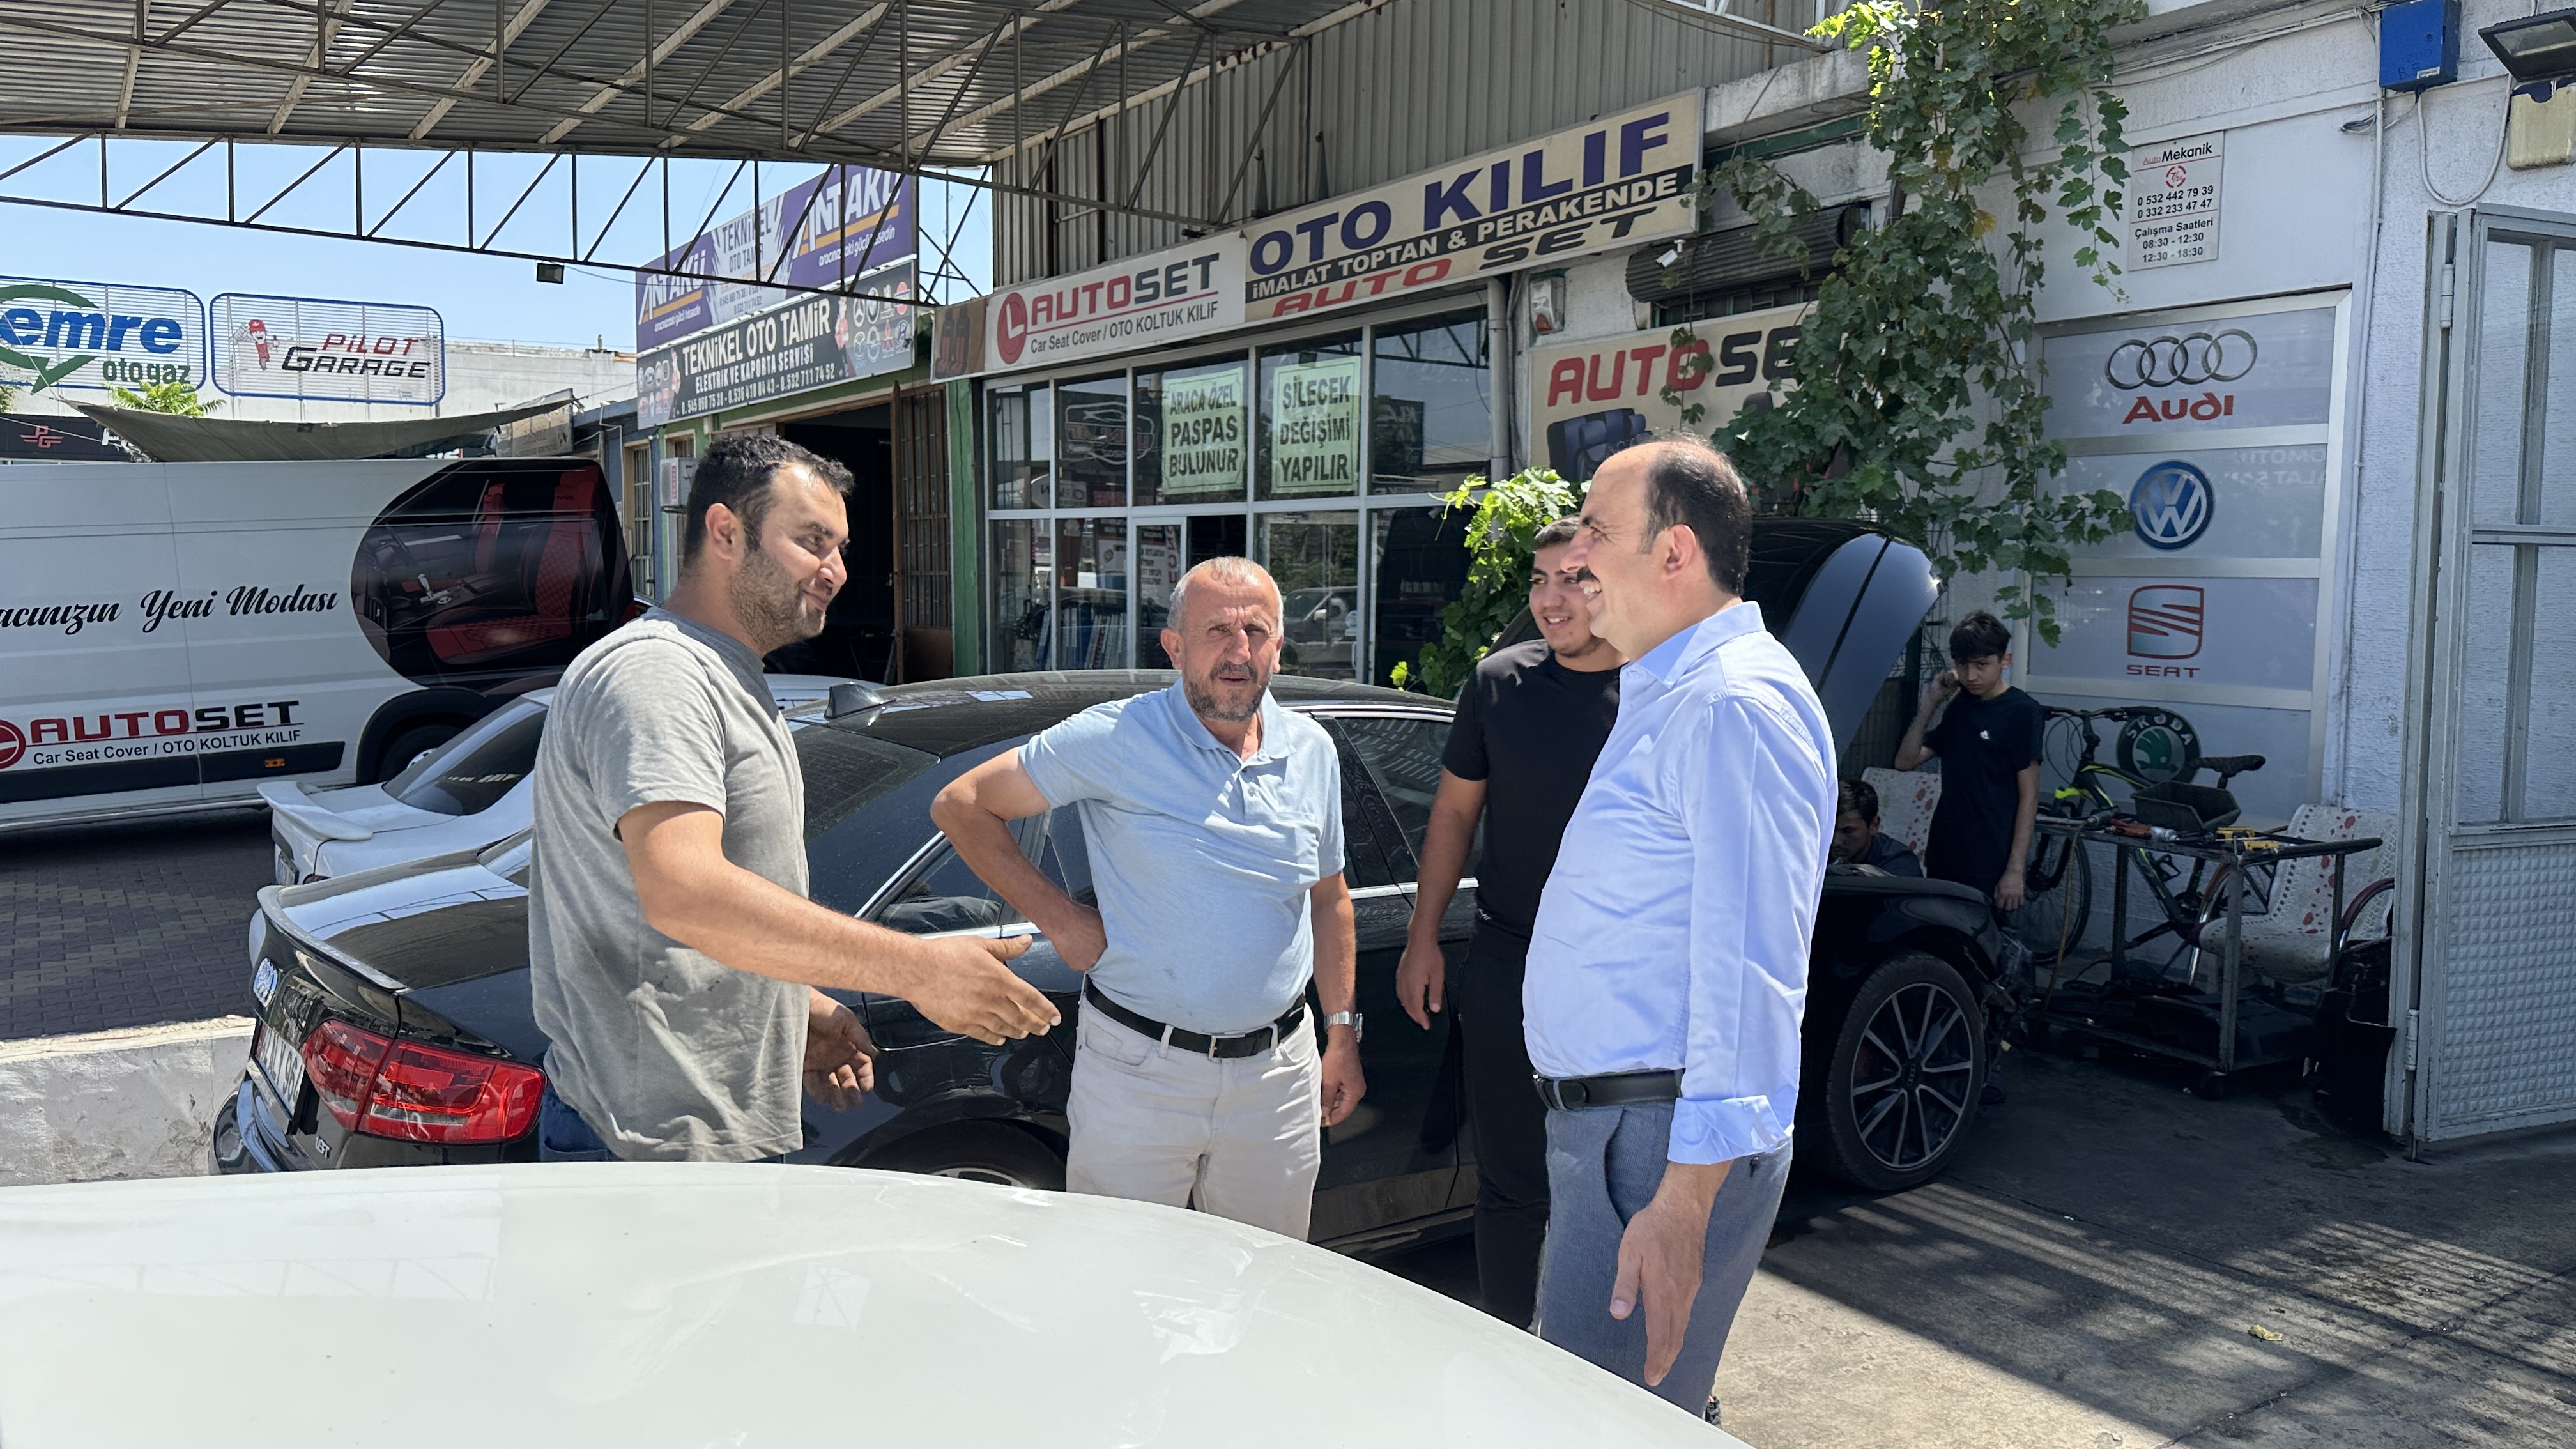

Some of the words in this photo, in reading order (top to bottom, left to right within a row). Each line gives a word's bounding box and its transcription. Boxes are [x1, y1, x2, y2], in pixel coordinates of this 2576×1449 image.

[1250, 201, 1392, 275] OTO
[1424, 112, 1669, 231] KILIF
[2138, 197, 2143, 206] 0
[2146, 194, 2163, 204] 532
[2166, 190, 2184, 201] 442
[2187, 188, 2198, 197] 79
[2202, 185, 2213, 195] 39
[2146, 206, 2163, 217] 332
[2166, 203, 2182, 214] 233
[2186, 201, 2197, 210] 47
[2200, 199, 2212, 208] 47
[1338, 236, 1437, 276] TOPTAN
[1447, 230, 1467, 250] &
[1478, 172, 1678, 242] PERAKENDE
[2135, 226, 2173, 240] Çalışma
[2176, 217, 2213, 231] Saatleri
[2142, 252, 2167, 263] 12:30
[2177, 247, 2203, 257] 18:30
[2143, 238, 2168, 249] 08:30
[2177, 233, 2204, 243] 12:30
[730, 252, 740, 273] OTO
[1272, 259, 1452, 318] AUTO
[1479, 206, 1657, 270] SET
[1032, 252, 1220, 326] AUTOSET
[1, 308, 183, 354] emre
[746, 316, 777, 357] OTO
[1031, 339, 1046, 353] Car
[1049, 335, 1070, 349] Seat
[1073, 328, 1101, 344] Cover
[1103, 325, 1107, 339] /
[1110, 320, 1133, 339] OTO
[1136, 309, 1184, 333] KOLTUK
[1188, 301, 1218, 323] KILIF
[102, 358, 191, 385] otogaz
[282, 346, 431, 378] GARAGE
[730, 365, 739, 385] VE
[740, 354, 776, 382] KAPORTA
[801, 368, 813, 387] 711
[815, 365, 824, 383] 74
[826, 363, 835, 380] 52
[1170, 388, 1206, 415] ARACA
[1208, 382, 1237, 410] ÖZEL
[1282, 374, 1352, 410] SİLECEK
[2122, 392, 2234, 424] Audi
[1171, 415, 1238, 448] PASPAS
[1280, 411, 1350, 448] DEĞİŞİMİ
[1170, 448, 1238, 477] BULUNUR
[1280, 454, 1349, 482] YAPILIR
[140, 590, 218, 633] Yeni
[226, 584, 339, 616] Modası
[2127, 664, 2200, 678] SEAT
[30, 700, 300, 744] AUTOSET
[34, 752, 60, 765] Car
[66, 749, 100, 762] Seat
[104, 744, 148, 759] Cover
[153, 743, 158, 755] /
[162, 739, 195, 754] OTO
[200, 733, 261, 751] KOLTUK
[265, 730, 301, 744] KILIF
